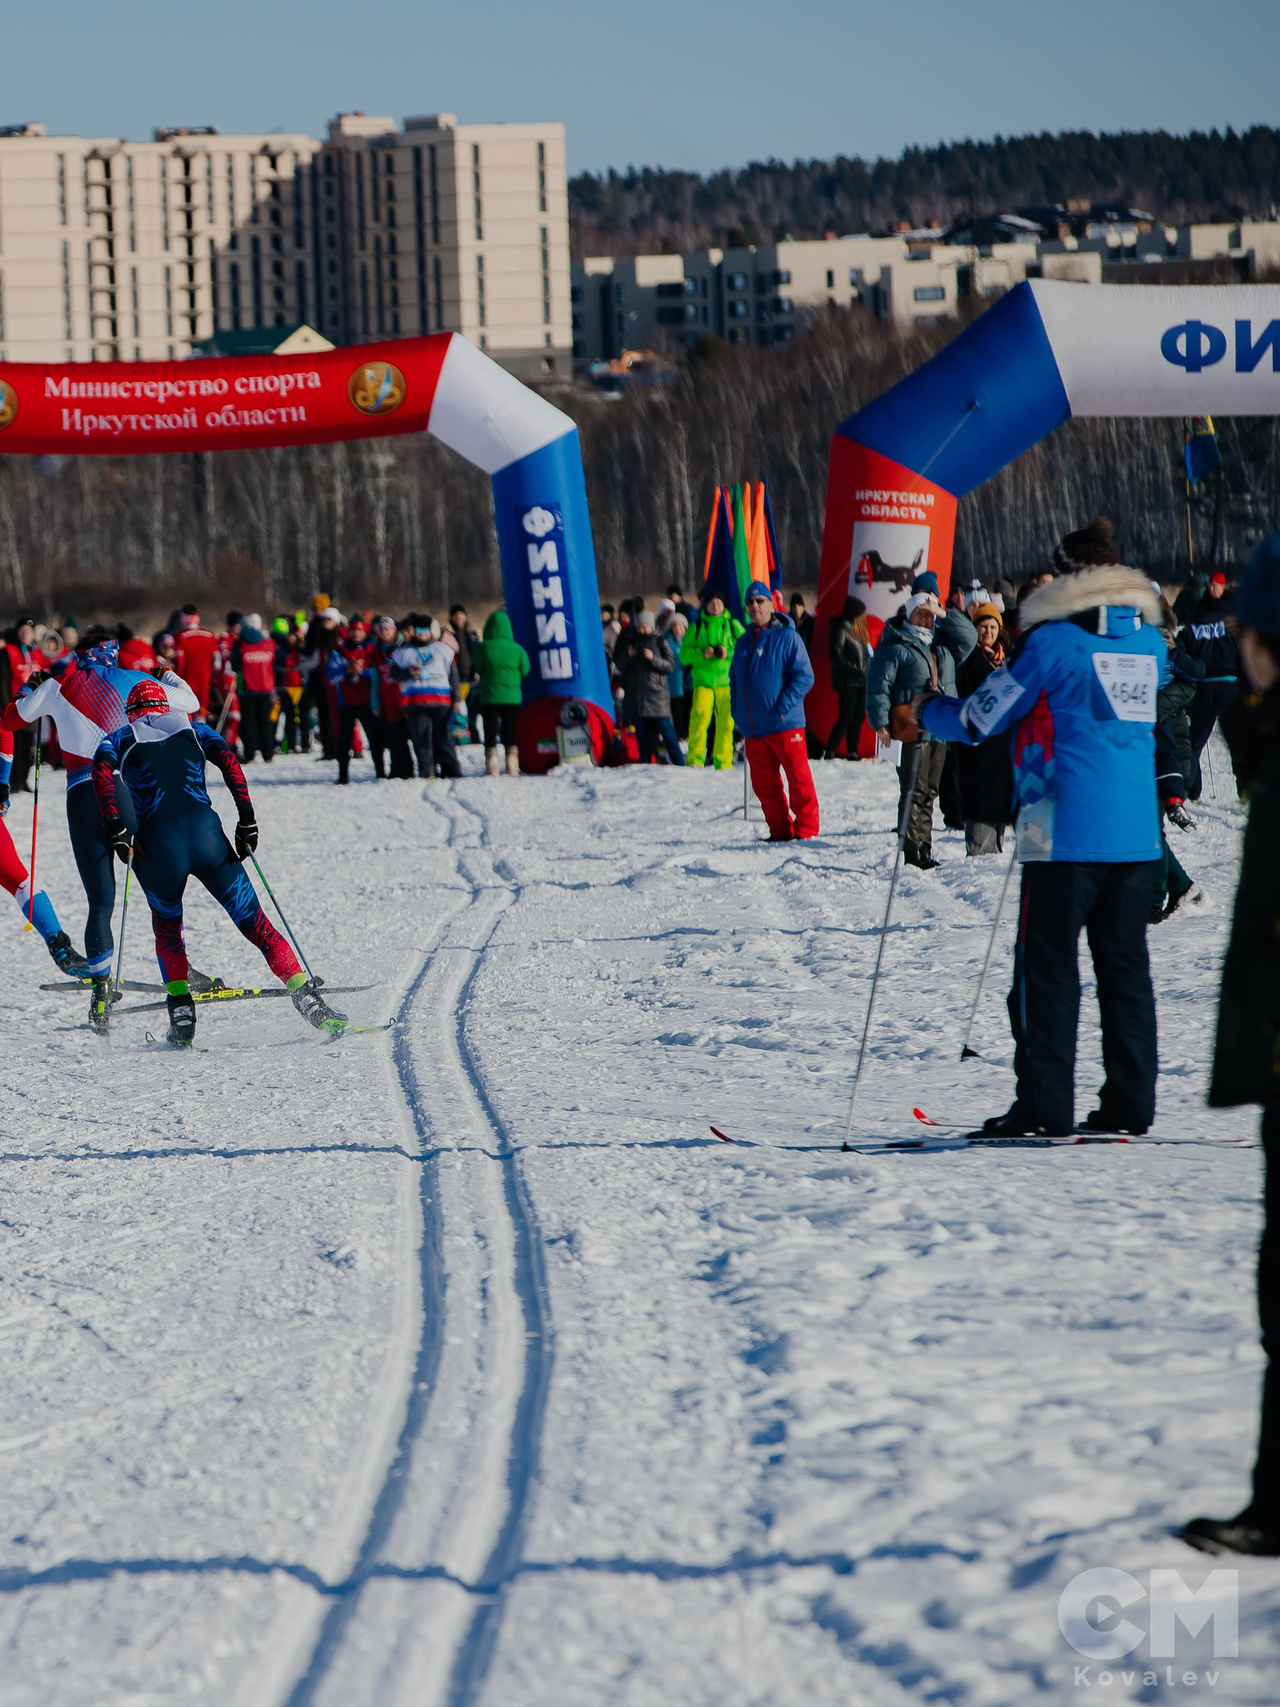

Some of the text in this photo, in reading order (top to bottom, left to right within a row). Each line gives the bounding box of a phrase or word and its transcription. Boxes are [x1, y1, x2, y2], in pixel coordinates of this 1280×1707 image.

[44, 371, 321, 404] Министерство спорта
[61, 404, 307, 435] Иркутской области
[855, 489, 935, 507] ИРКУТСКАЯ
[861, 504, 927, 520] ОБЛАСТЬ
[522, 506, 573, 679] ФИНИШ
